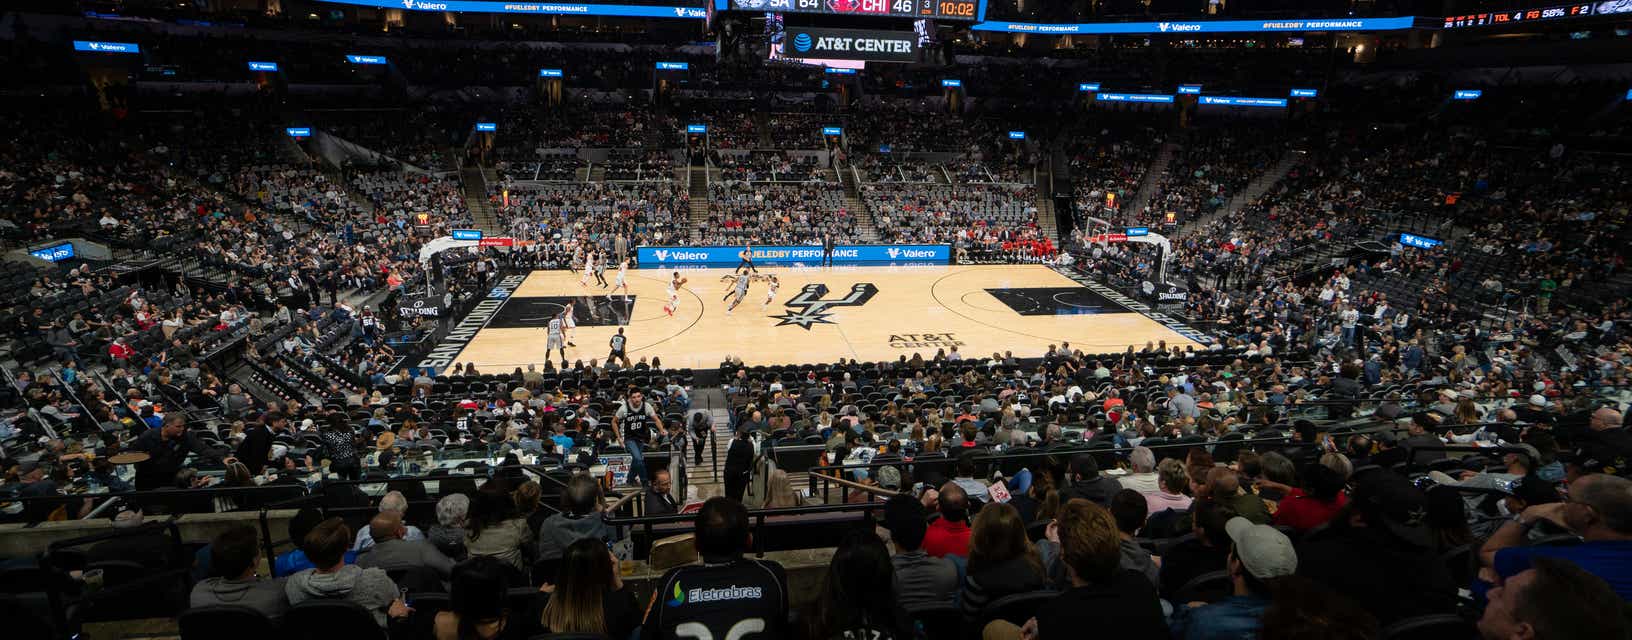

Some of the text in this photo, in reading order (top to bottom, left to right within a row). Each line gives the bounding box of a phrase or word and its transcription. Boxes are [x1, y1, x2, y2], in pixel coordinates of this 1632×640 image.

[417, 0, 447, 10] Valero
[542, 4, 588, 12] PERFORMANCE
[799, 0, 819, 8] 64
[863, 0, 886, 11] CHI
[893, 0, 912, 12] 46
[925, 0, 930, 8] 3
[940, 3, 974, 15] 10:02
[688, 9, 706, 17] Vale
[1526, 10, 1540, 19] FG
[1571, 5, 1589, 14] F 2
[1495, 14, 1510, 22] TOL
[1514, 12, 1523, 20] 4
[1172, 23, 1200, 32] Valero
[815, 37, 911, 52] AT&T CENTER
[672, 250, 708, 260] Valero
[903, 249, 936, 259] Valero
[1158, 292, 1187, 300] SPALDING
[417, 343, 466, 368] SAN
[445, 299, 504, 342] ANTONIO
[889, 333, 955, 342] AT&T
[456, 420, 467, 430] 21
[688, 585, 762, 603] Eletrobras
